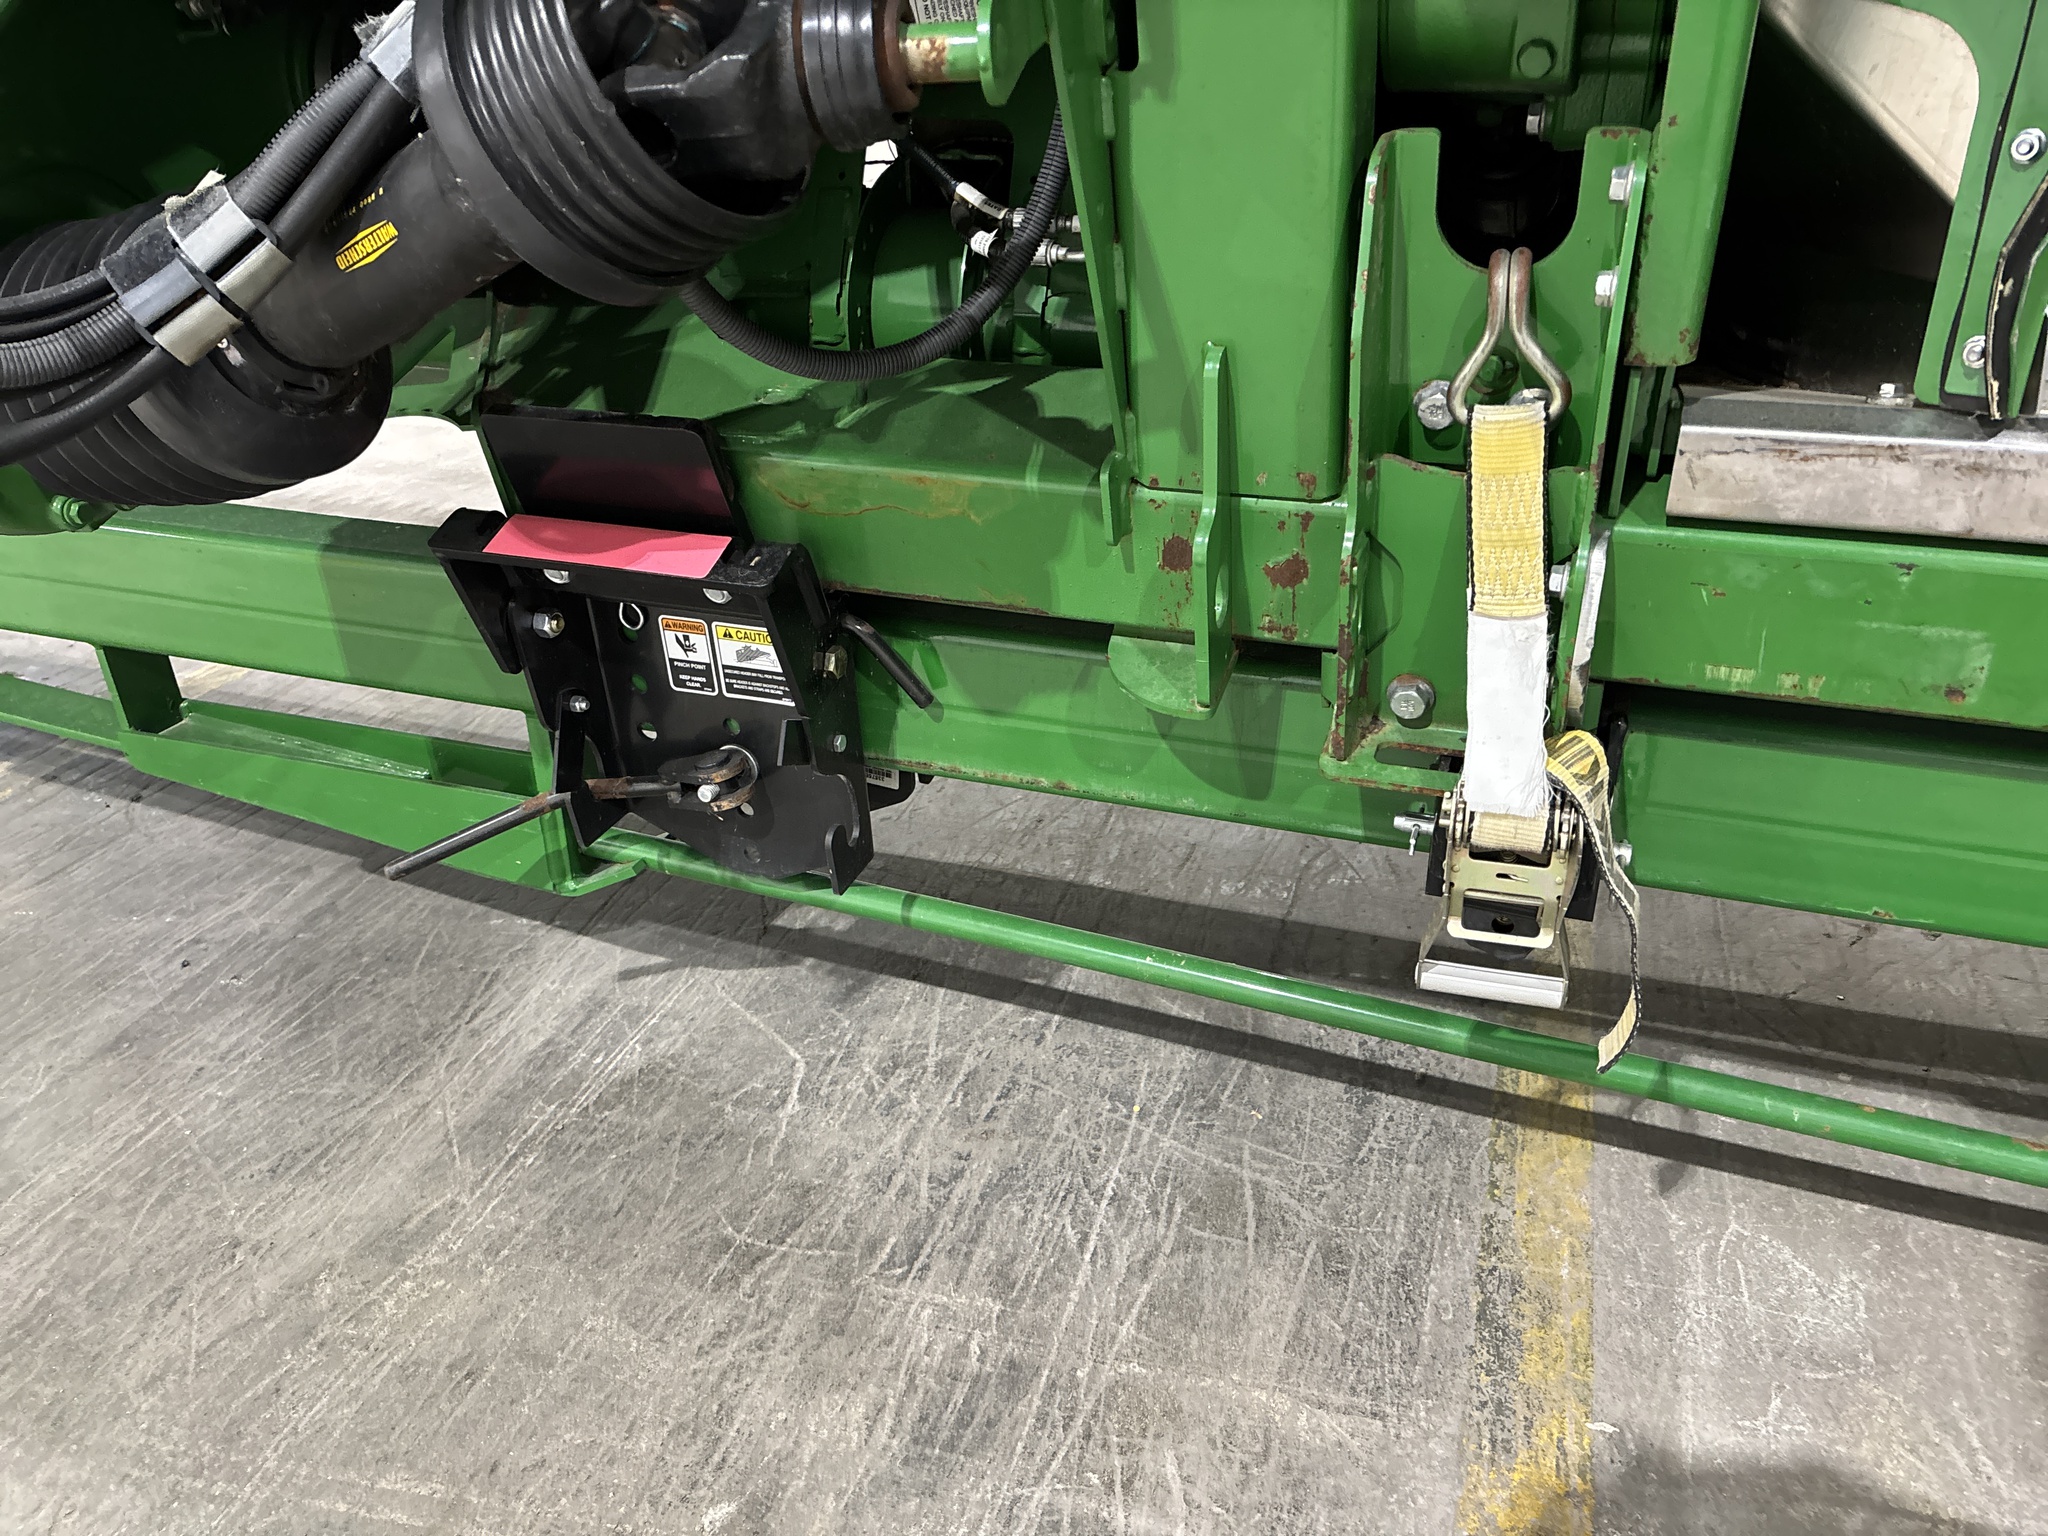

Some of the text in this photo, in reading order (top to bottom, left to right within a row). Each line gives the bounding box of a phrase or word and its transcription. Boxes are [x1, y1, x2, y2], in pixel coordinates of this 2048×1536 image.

[335, 221, 399, 271] WALTERSCHEID
[671, 621, 704, 633] WARNING
[735, 630, 773, 644] CAUTIO
